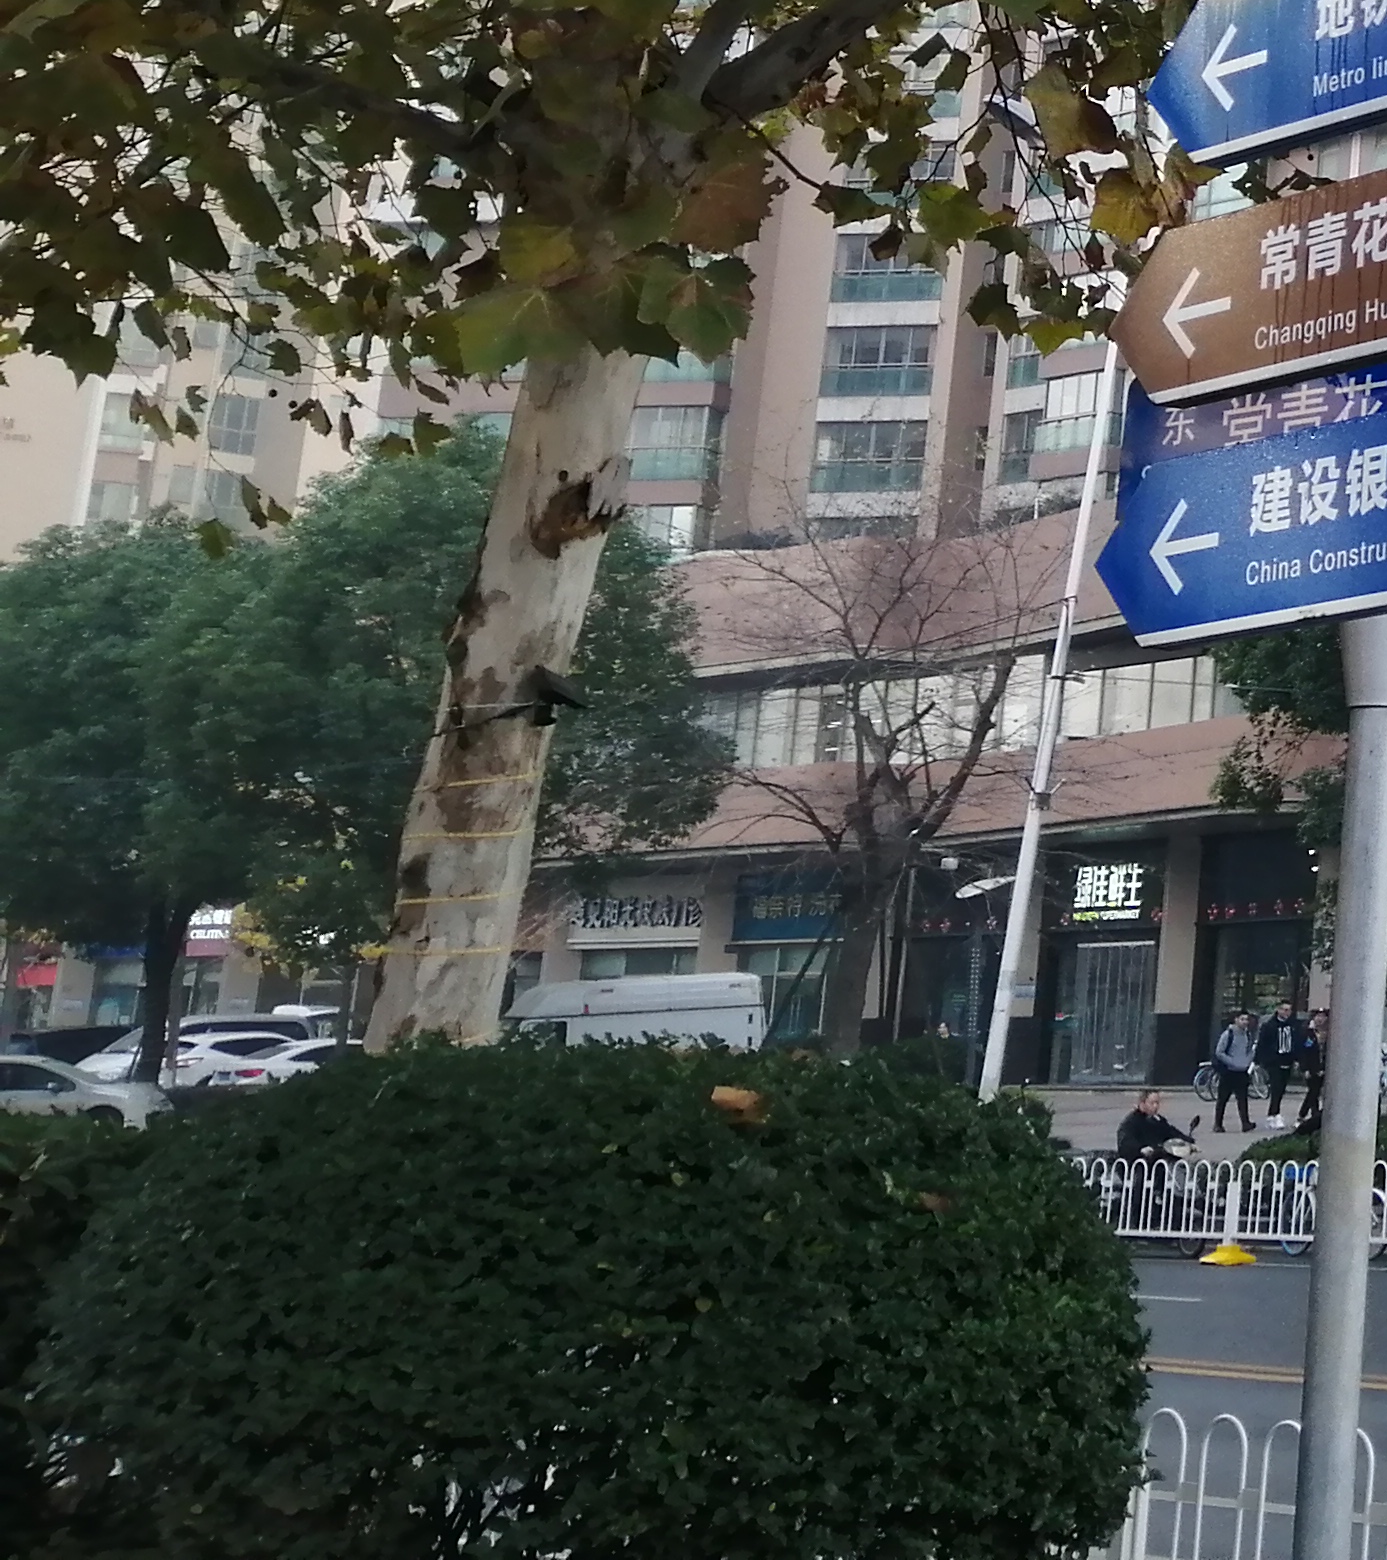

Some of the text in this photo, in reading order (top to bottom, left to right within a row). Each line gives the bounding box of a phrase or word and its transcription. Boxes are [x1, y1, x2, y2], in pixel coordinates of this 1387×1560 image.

[1313, 68, 1365, 98] Metro
[1254, 309, 1357, 350] Changqing
[1246, 558, 1300, 585] China
